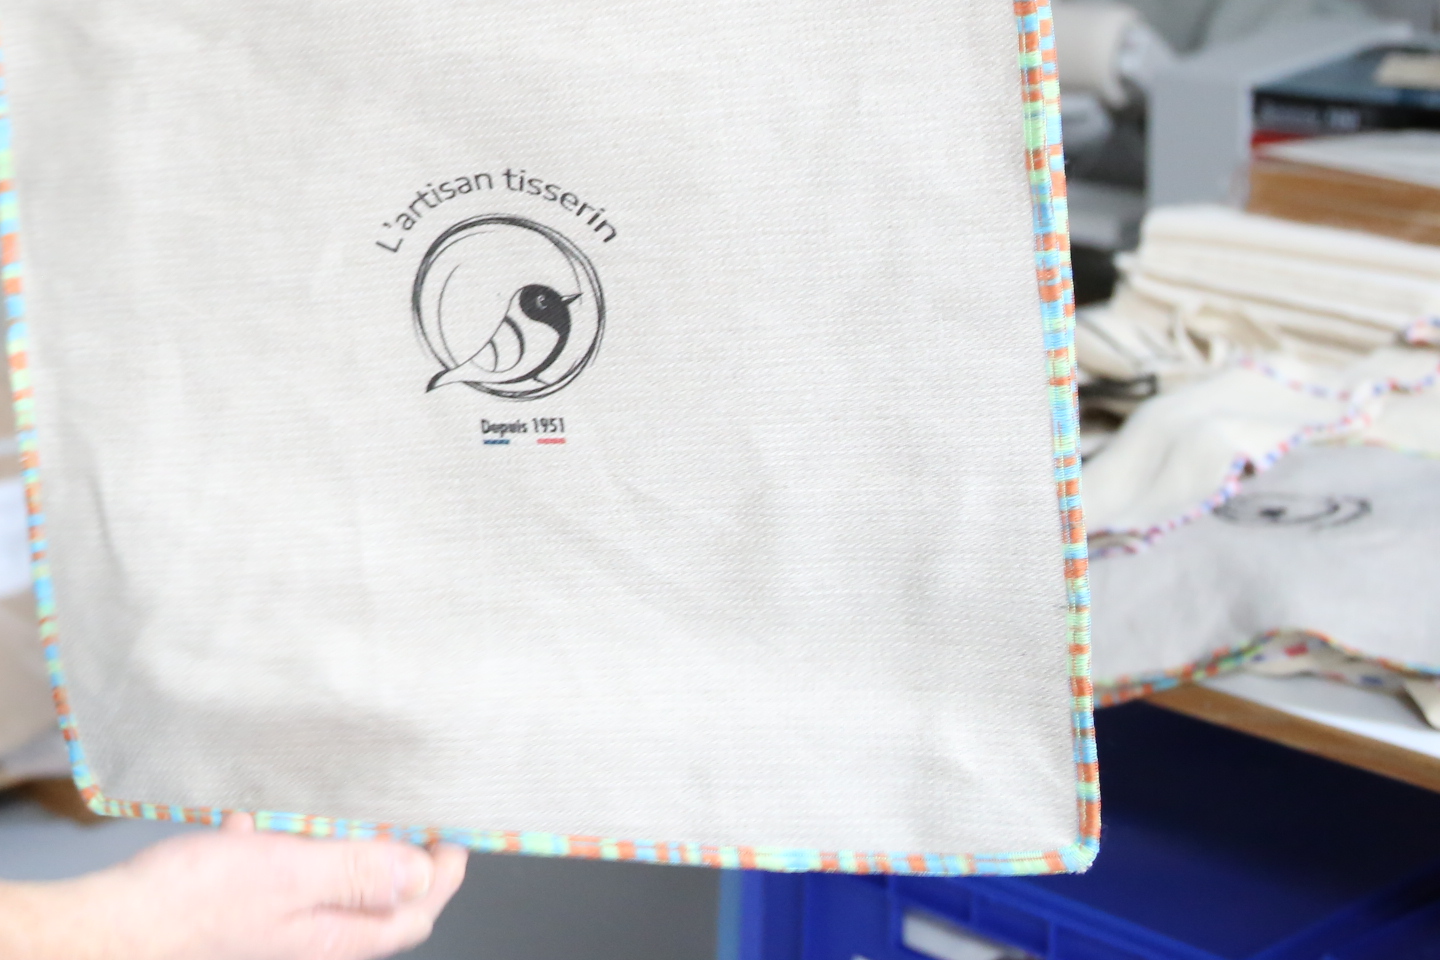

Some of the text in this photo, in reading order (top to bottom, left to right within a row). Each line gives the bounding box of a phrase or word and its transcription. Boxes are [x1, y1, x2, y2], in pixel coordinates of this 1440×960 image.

[375, 168, 618, 253] L'artisan tisserin
[480, 417, 565, 437] Depuis 1951
